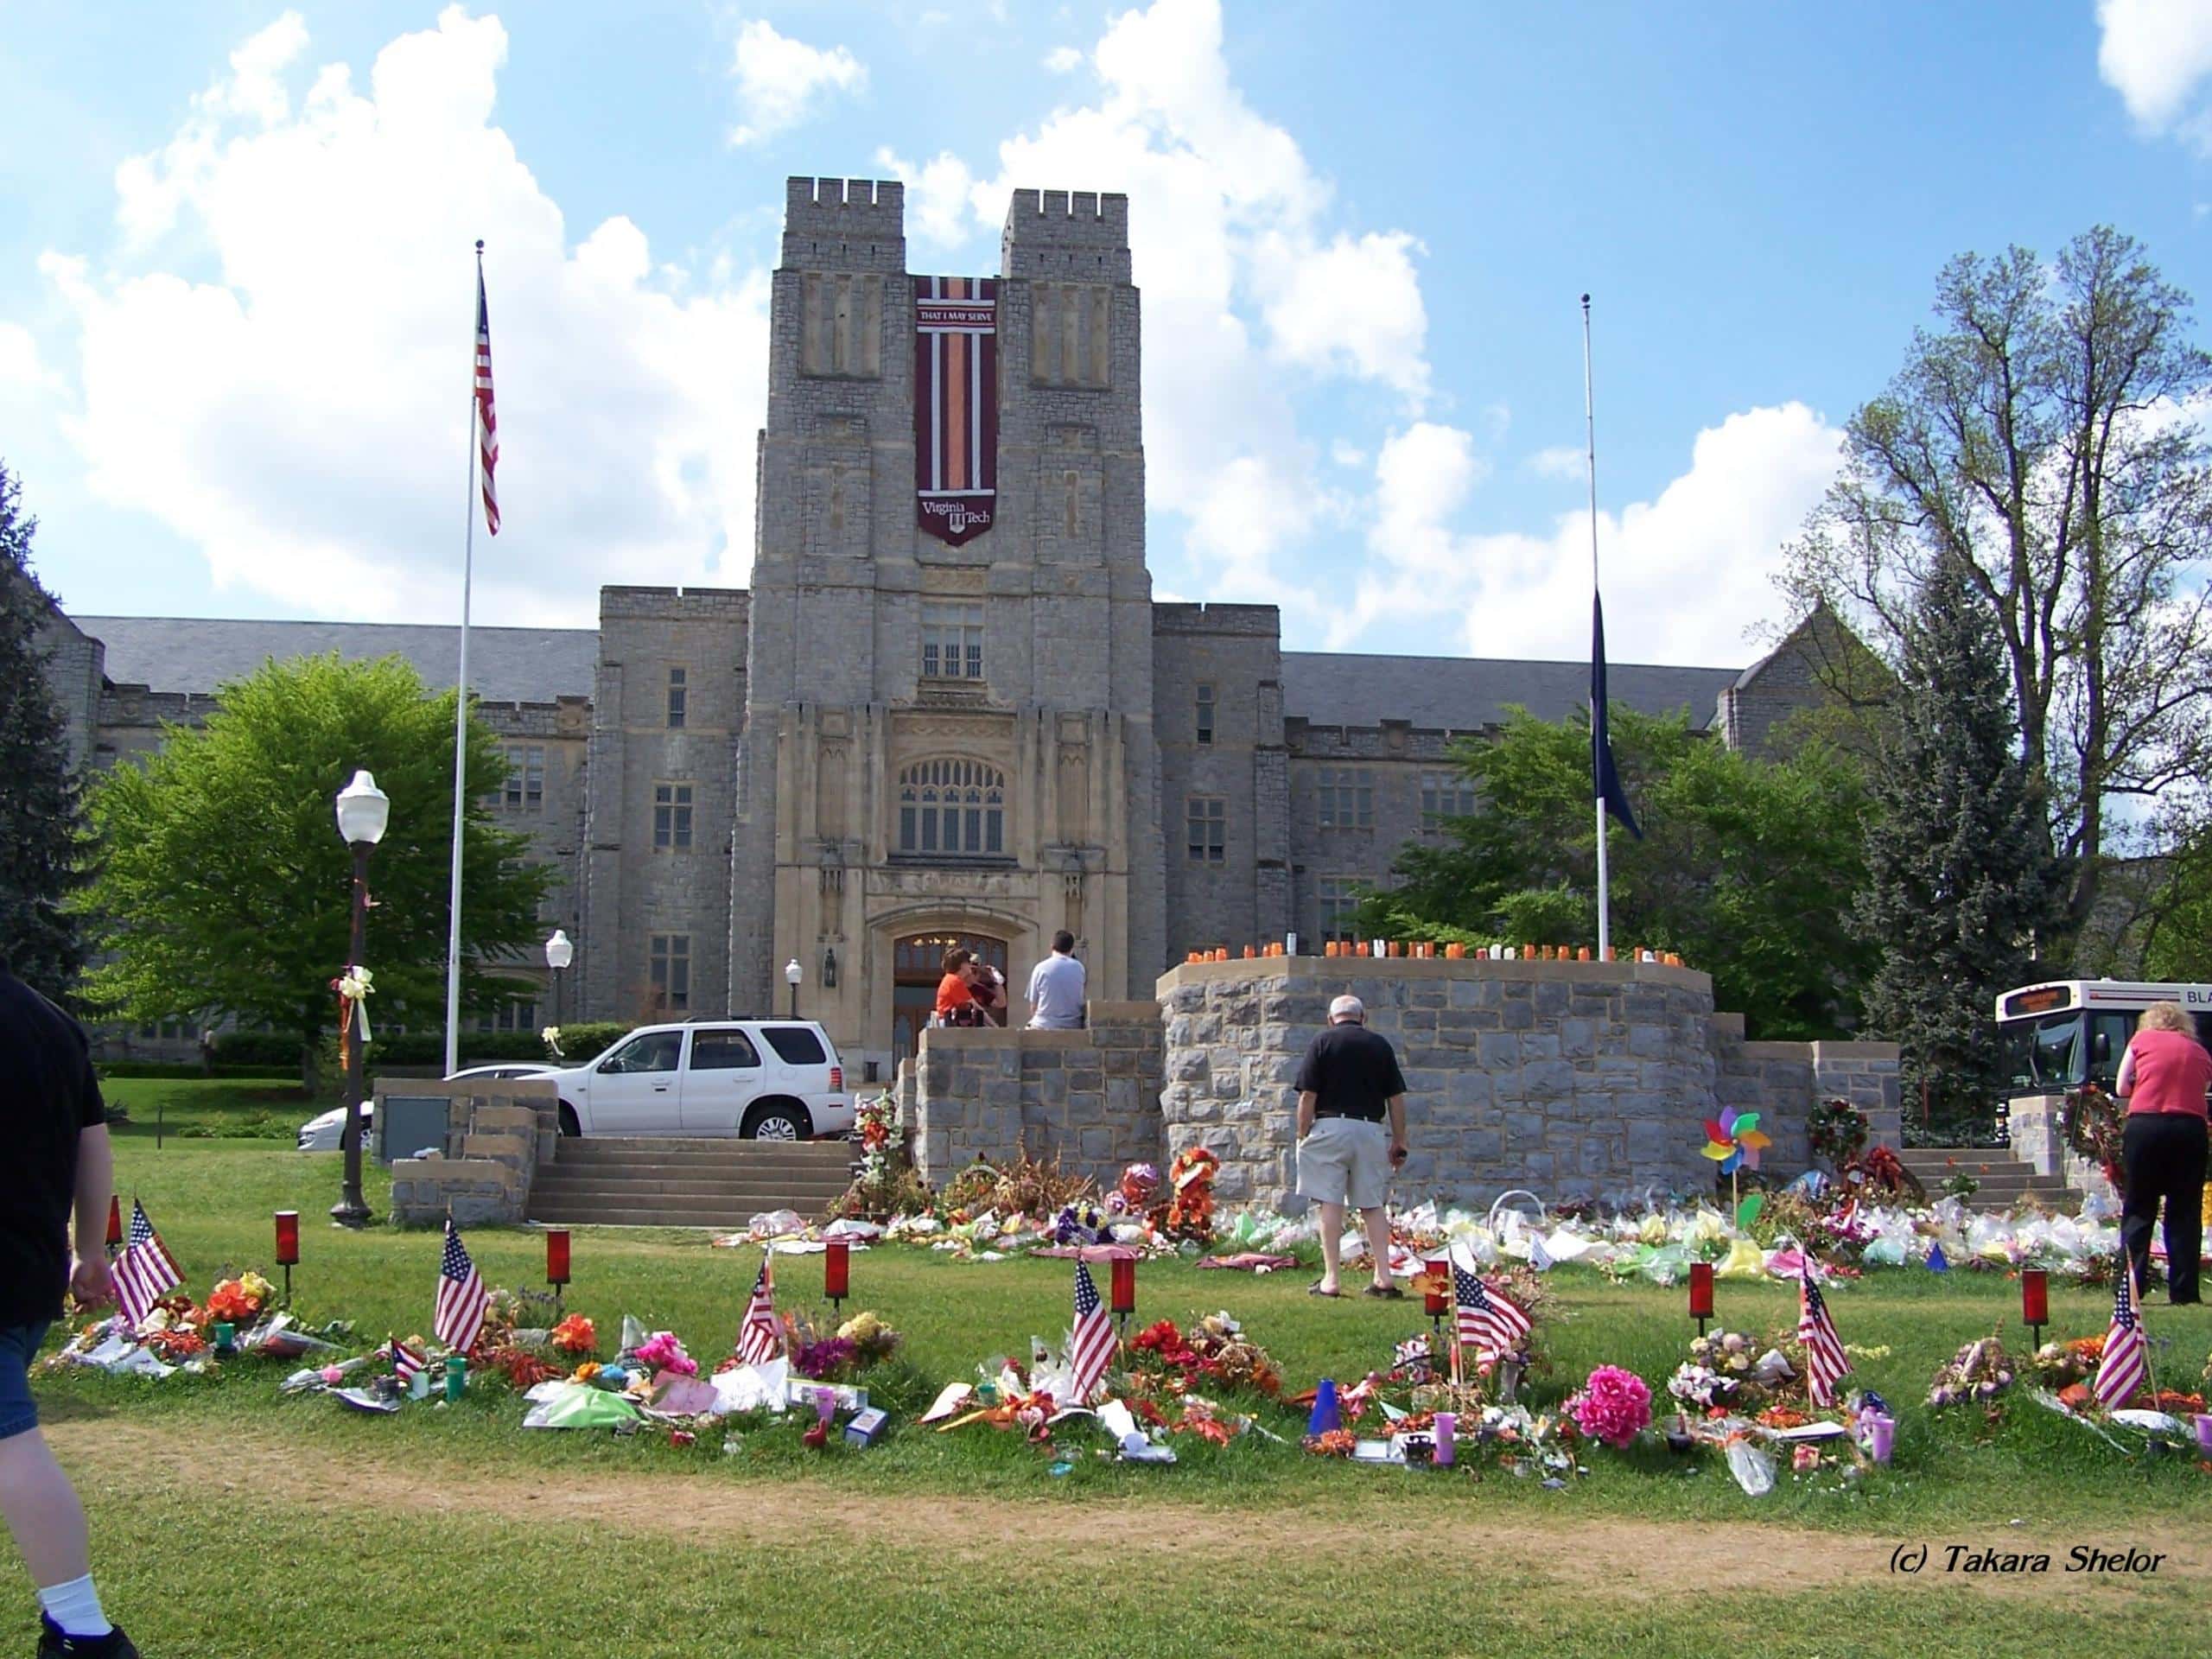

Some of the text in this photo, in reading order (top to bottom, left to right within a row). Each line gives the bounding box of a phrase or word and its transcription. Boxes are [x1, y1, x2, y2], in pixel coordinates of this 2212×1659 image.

[948, 312, 967, 321] MAY
[922, 501, 964, 515] Virginia
[966, 511, 990, 523] Tech
